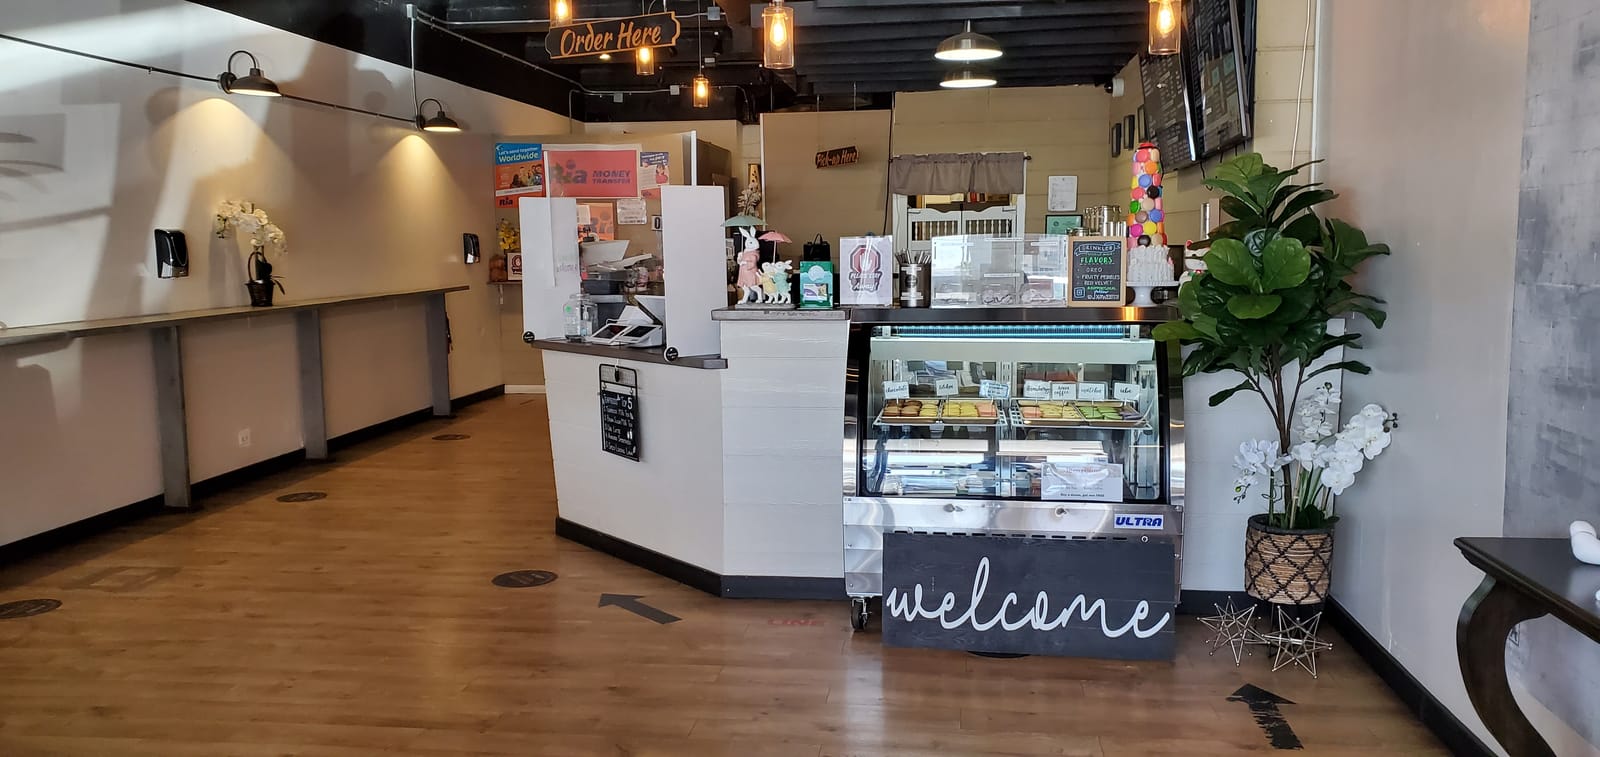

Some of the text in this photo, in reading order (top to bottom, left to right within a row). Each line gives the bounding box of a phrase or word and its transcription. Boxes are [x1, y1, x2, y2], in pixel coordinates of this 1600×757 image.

[560, 21, 662, 57] Order Here
[498, 152, 539, 163] Worldwide
[592, 170, 631, 178] MONEY
[1080, 256, 1113, 265] FLAVORS
[627, 397, 633, 410] 5
[1115, 517, 1162, 527] ULTRA
[886, 556, 1171, 639] welcome
